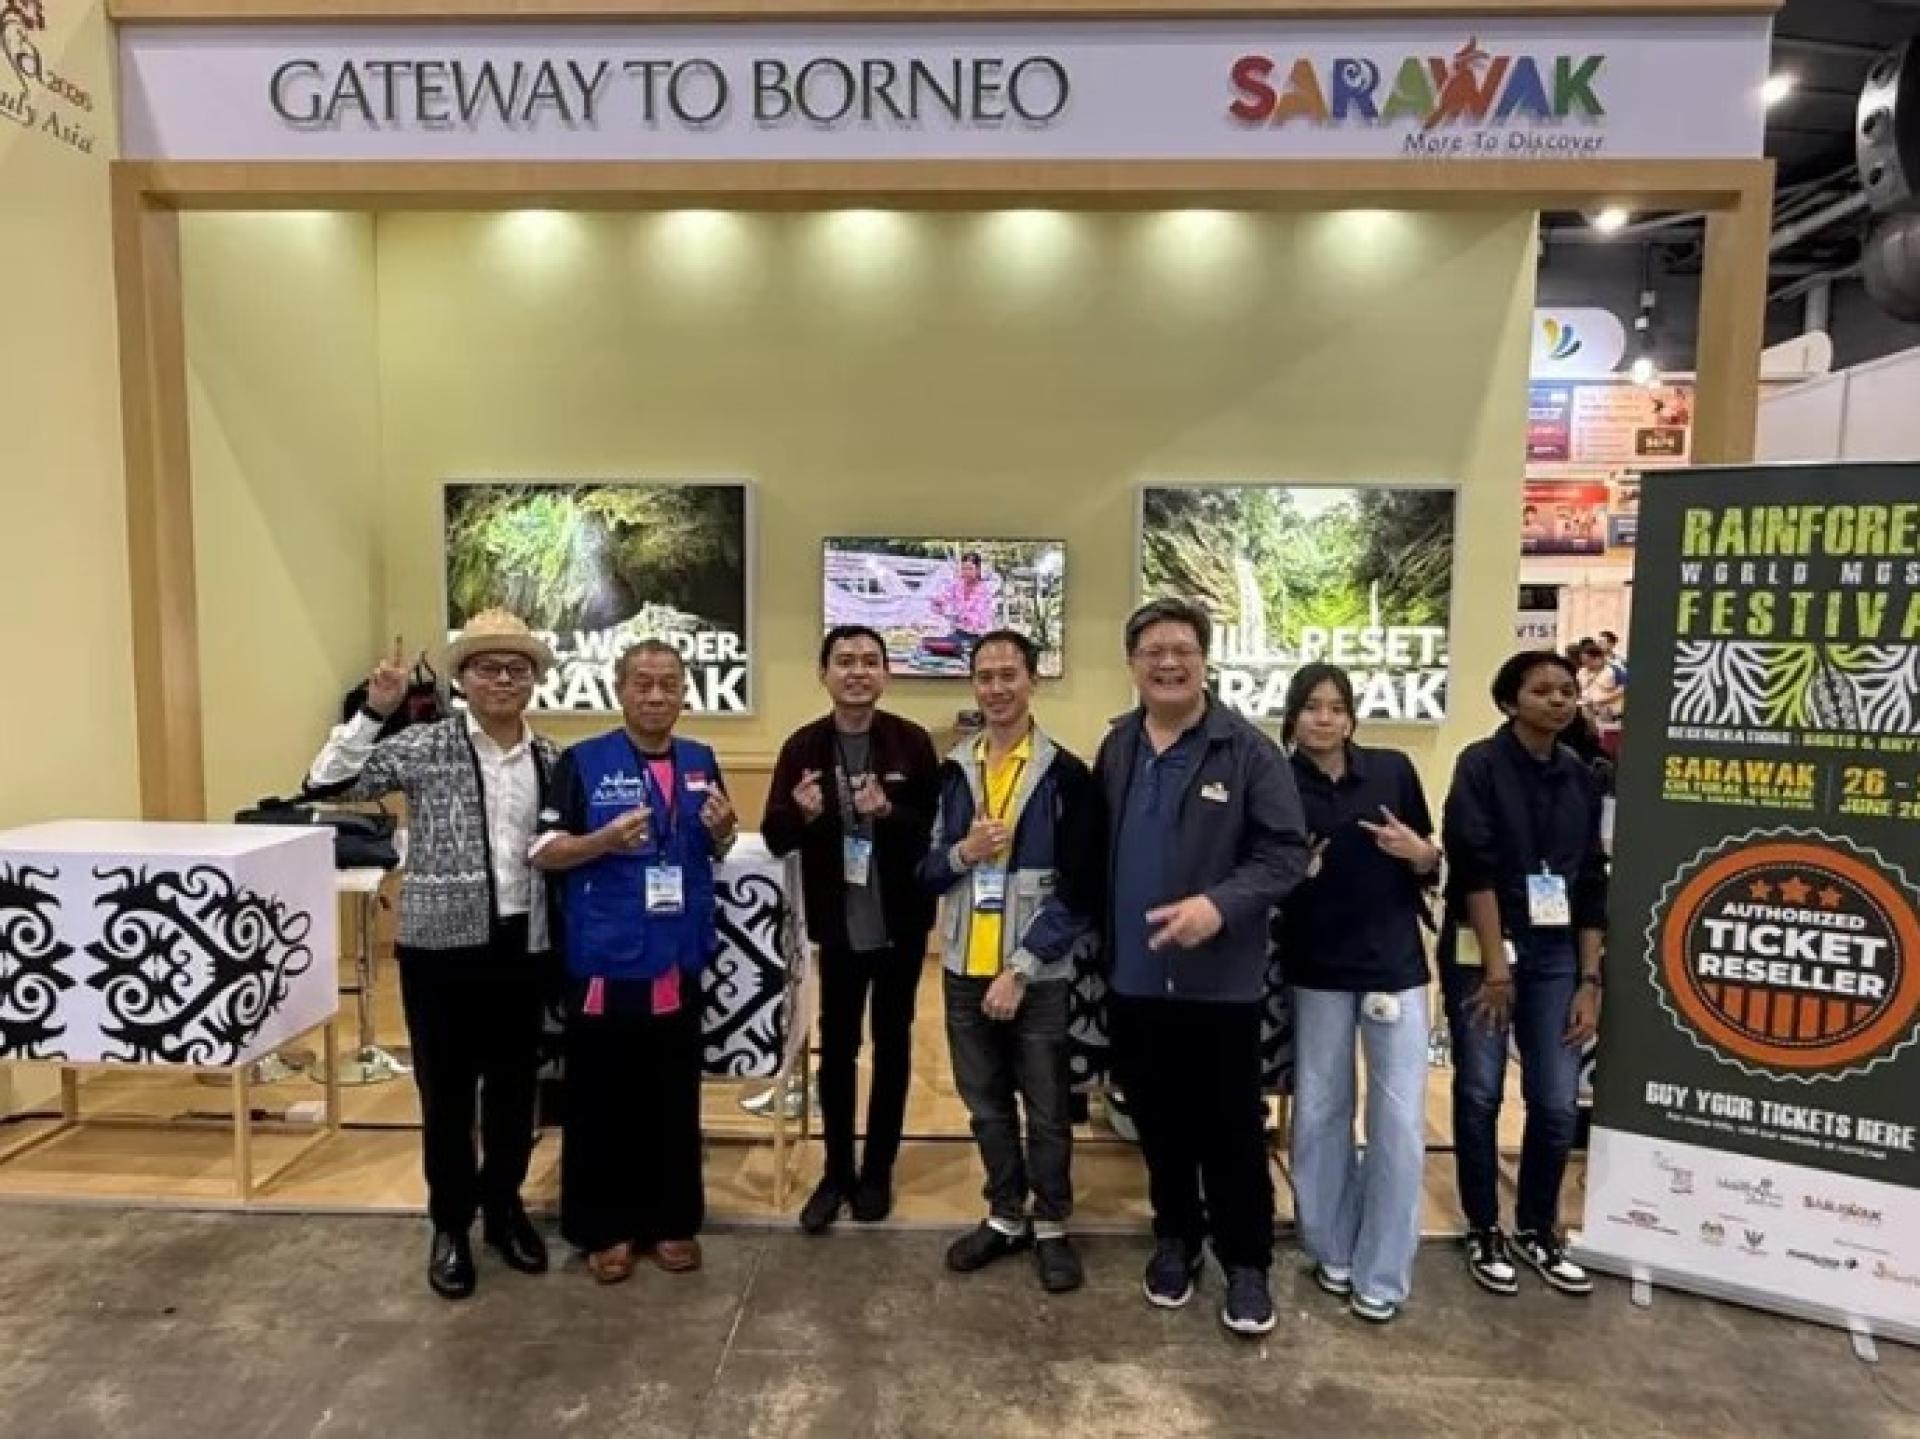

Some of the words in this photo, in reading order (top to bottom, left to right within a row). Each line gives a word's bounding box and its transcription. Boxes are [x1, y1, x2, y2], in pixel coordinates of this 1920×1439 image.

[269, 58, 610, 123] GATEWAY
[623, 58, 728, 124] TO
[752, 56, 1070, 124] BORNEO
[1228, 48, 1607, 128] SARAWAK
[1404, 132, 1463, 153] More
[1473, 132, 1498, 152] To
[1508, 131, 1605, 153] Discover
[1681, 503, 1920, 557] RAINFORE
[1665, 756, 1817, 786] SARAWAK
[1843, 767, 1887, 795] 26
[1721, 902, 1867, 930] AUTHORIZED
[1703, 918, 1888, 969] TICKET
[1698, 952, 1887, 999] RESELLER
[1645, 1081, 1689, 1108] BUY
[1696, 1089, 1753, 1121] YOUR
[1760, 1100, 1850, 1138] TICKETS
[1856, 1117, 1918, 1151] HERE
